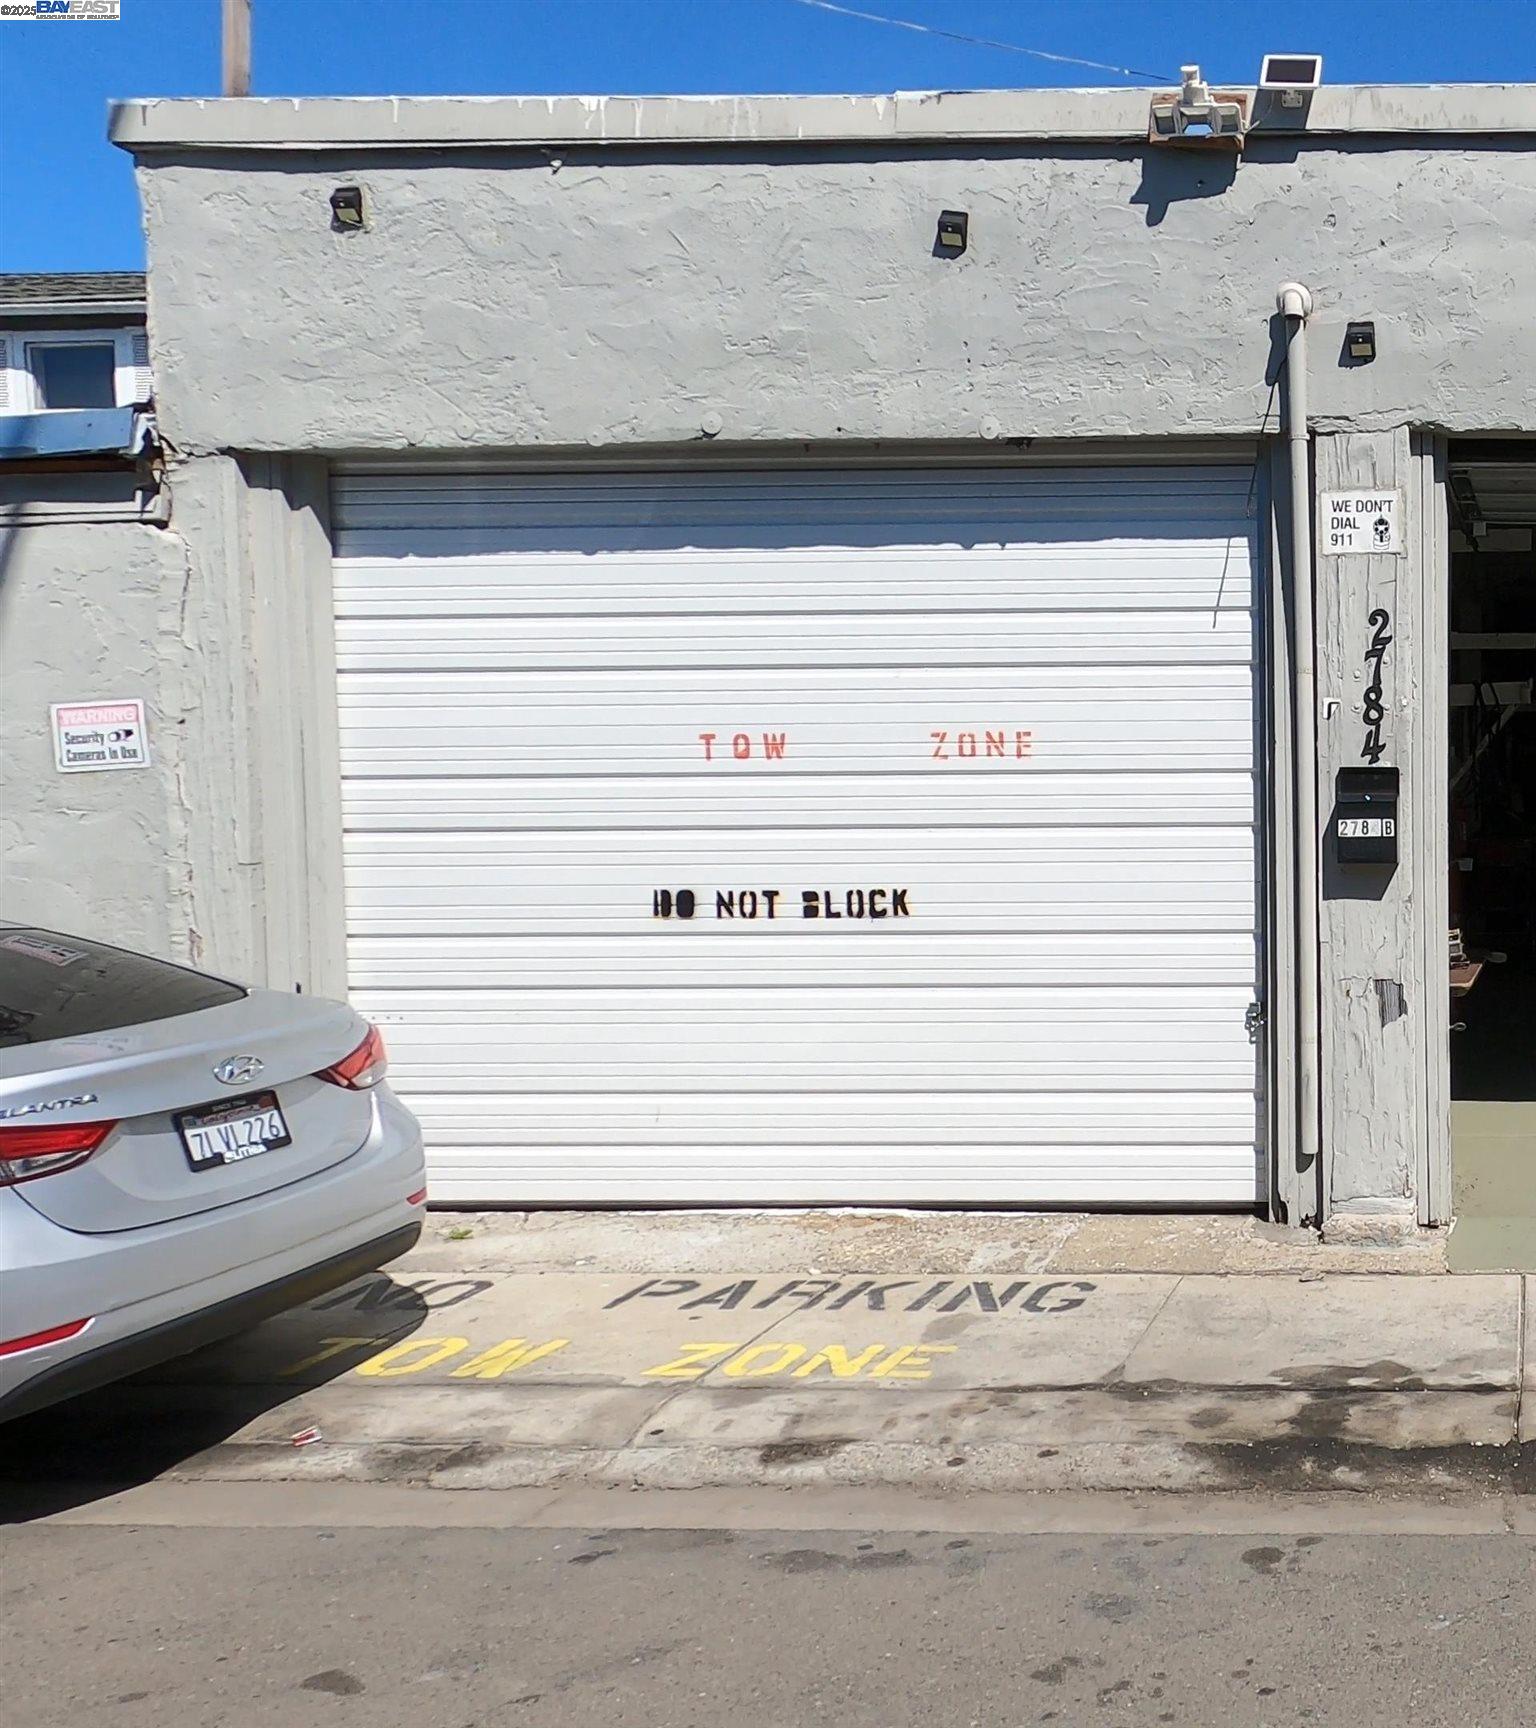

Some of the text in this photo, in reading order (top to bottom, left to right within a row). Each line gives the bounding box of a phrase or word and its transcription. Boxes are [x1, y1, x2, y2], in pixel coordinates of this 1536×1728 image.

[1331, 499, 1393, 512] WE DON'T
[1331, 517, 1360, 529] DIAL
[1331, 533, 1352, 546] 911
[1361, 609, 1392, 765] 2784
[64, 730, 104, 746] Security
[699, 731, 1032, 761] TOW ZONE
[66, 749, 106, 762] Cameras
[653, 889, 910, 919] DO NOT BLOCK
[312, 1278, 1099, 1313] NO PARKING
[277, 1336, 958, 1379] TOW ZONE
